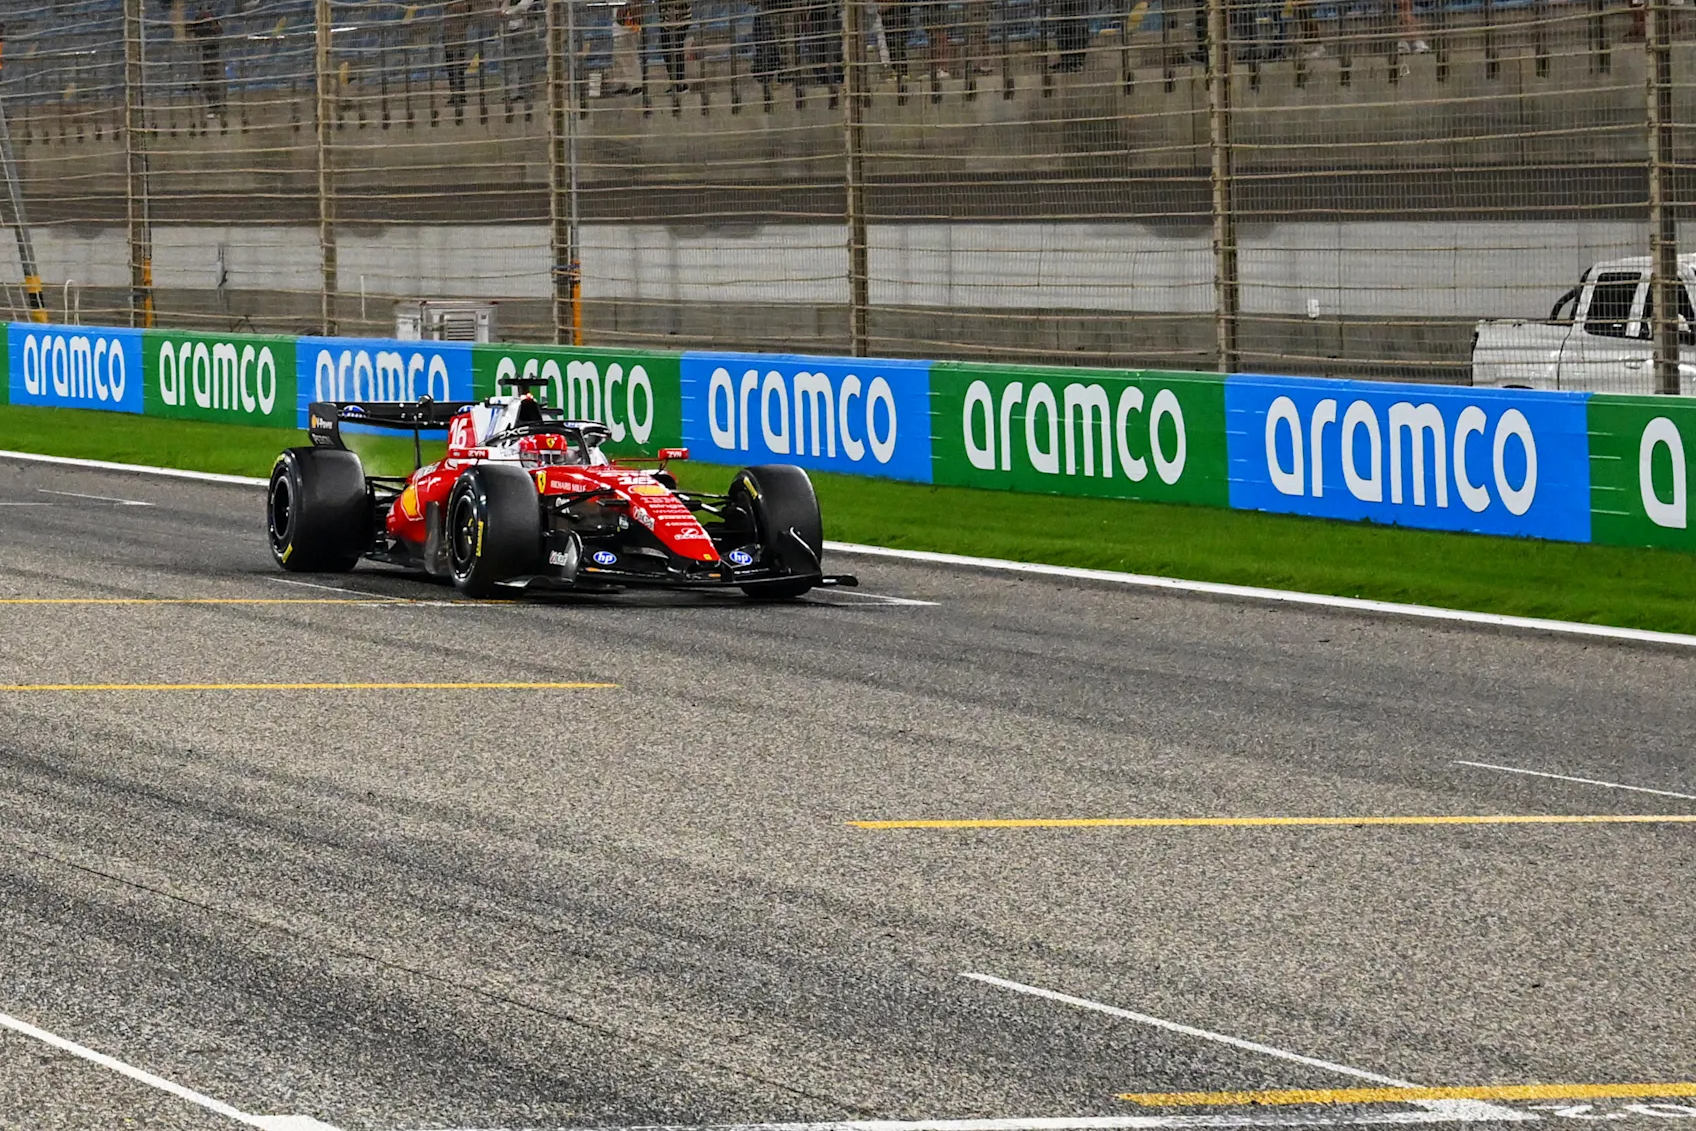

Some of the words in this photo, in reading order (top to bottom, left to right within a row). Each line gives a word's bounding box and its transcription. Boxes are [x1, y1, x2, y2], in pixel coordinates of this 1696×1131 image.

[23, 334, 126, 403] aramco
[159, 340, 276, 416] aramco
[315, 349, 450, 404] aramco
[449, 417, 468, 450] 16
[708, 367, 898, 464] aramco
[963, 380, 1187, 485] aramco
[550, 480, 572, 491] RICHARD
[571, 483, 587, 493] MILLE
[1265, 395, 1538, 516] aramco
[1639, 417, 1687, 529] a
[597, 551, 613, 565] hp
[733, 551, 750, 564] hp
